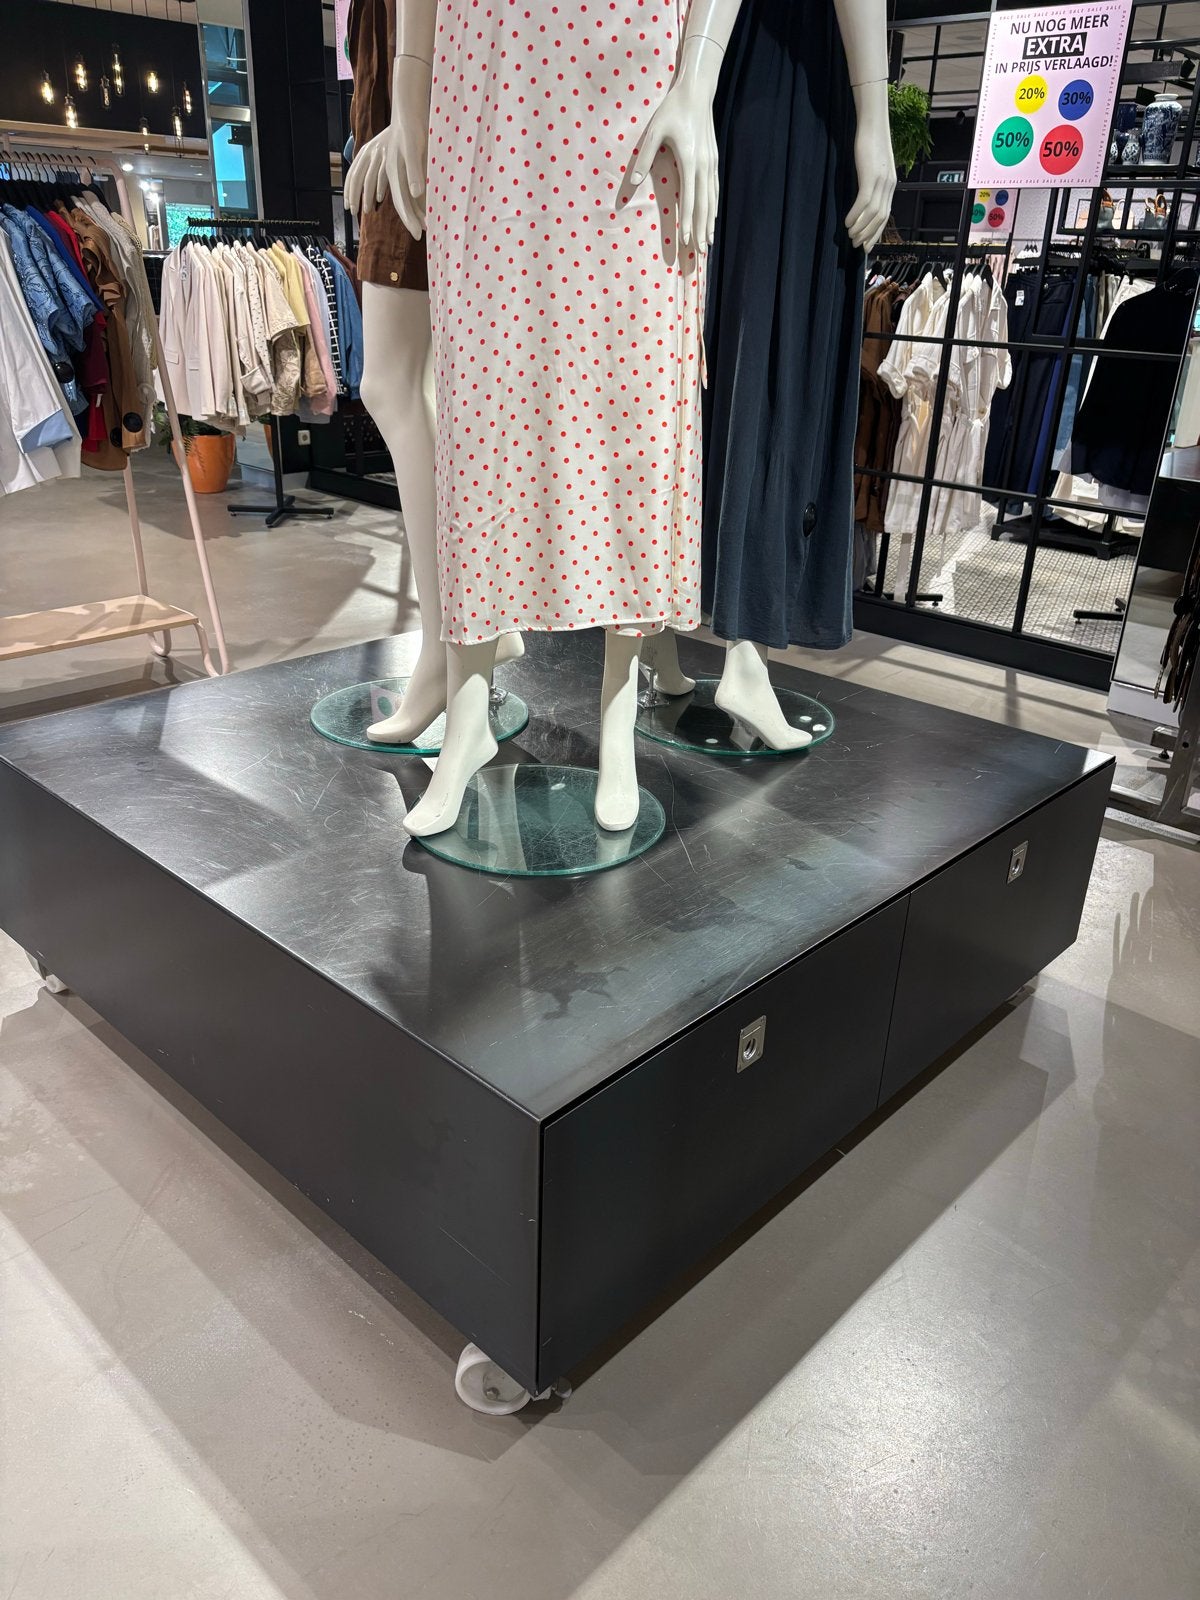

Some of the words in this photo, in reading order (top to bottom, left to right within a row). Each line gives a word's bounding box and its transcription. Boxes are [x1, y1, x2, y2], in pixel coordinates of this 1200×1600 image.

[1010, 22, 1030, 35] NU
[1034, 18, 1066, 33] NOG
[1070, 14, 1109, 30] MEER
[1026, 34, 1083, 56] EXTRA
[995, 63, 1008, 74] IN
[1012, 60, 1041, 74] PRIJS
[1044, 56, 1114, 71] VERLAAGD!
[1019, 88, 1045, 100] 20%
[1062, 91, 1092, 106] 30%
[995, 132, 1030, 148] 50%
[1042, 141, 1079, 158] 50%
